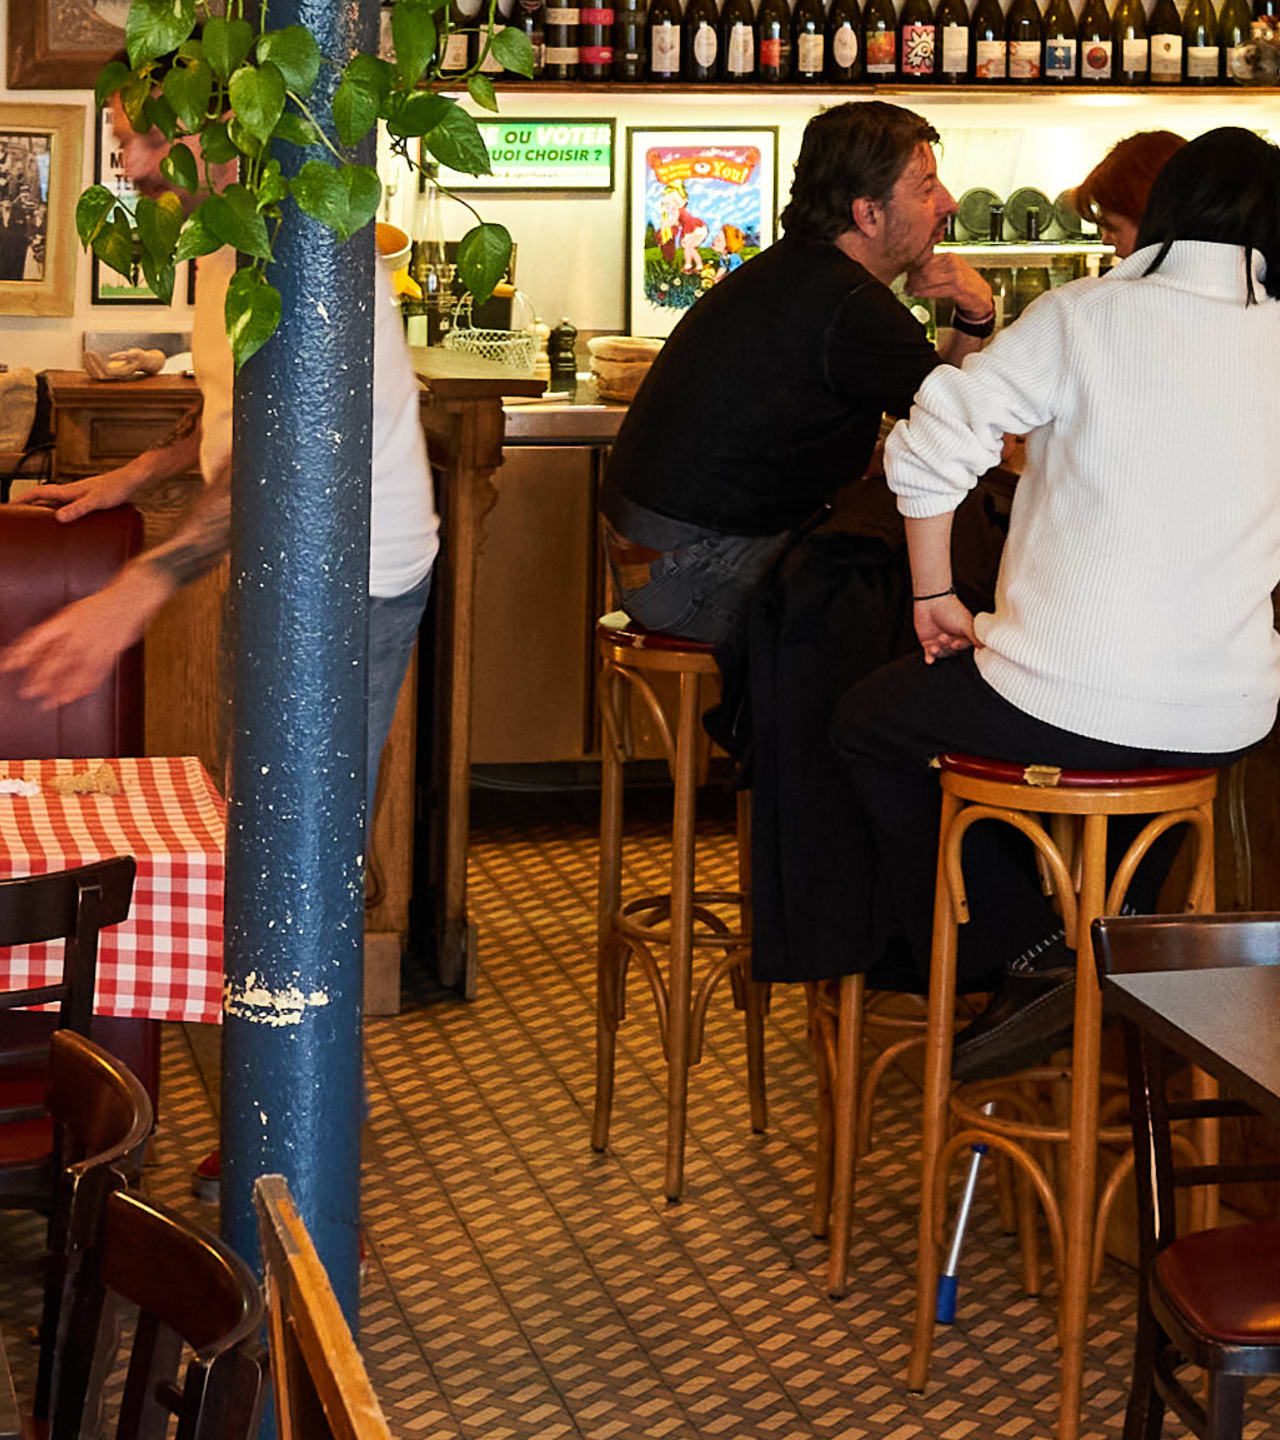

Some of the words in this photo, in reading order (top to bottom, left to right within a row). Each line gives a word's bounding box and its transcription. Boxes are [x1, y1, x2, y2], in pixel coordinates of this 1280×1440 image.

[504, 131, 532, 144] OU
[536, 127, 611, 146] VOTER
[487, 150, 521, 162] UOI
[525, 150, 590, 162] CHOISIR
[594, 150, 603, 162] ?
